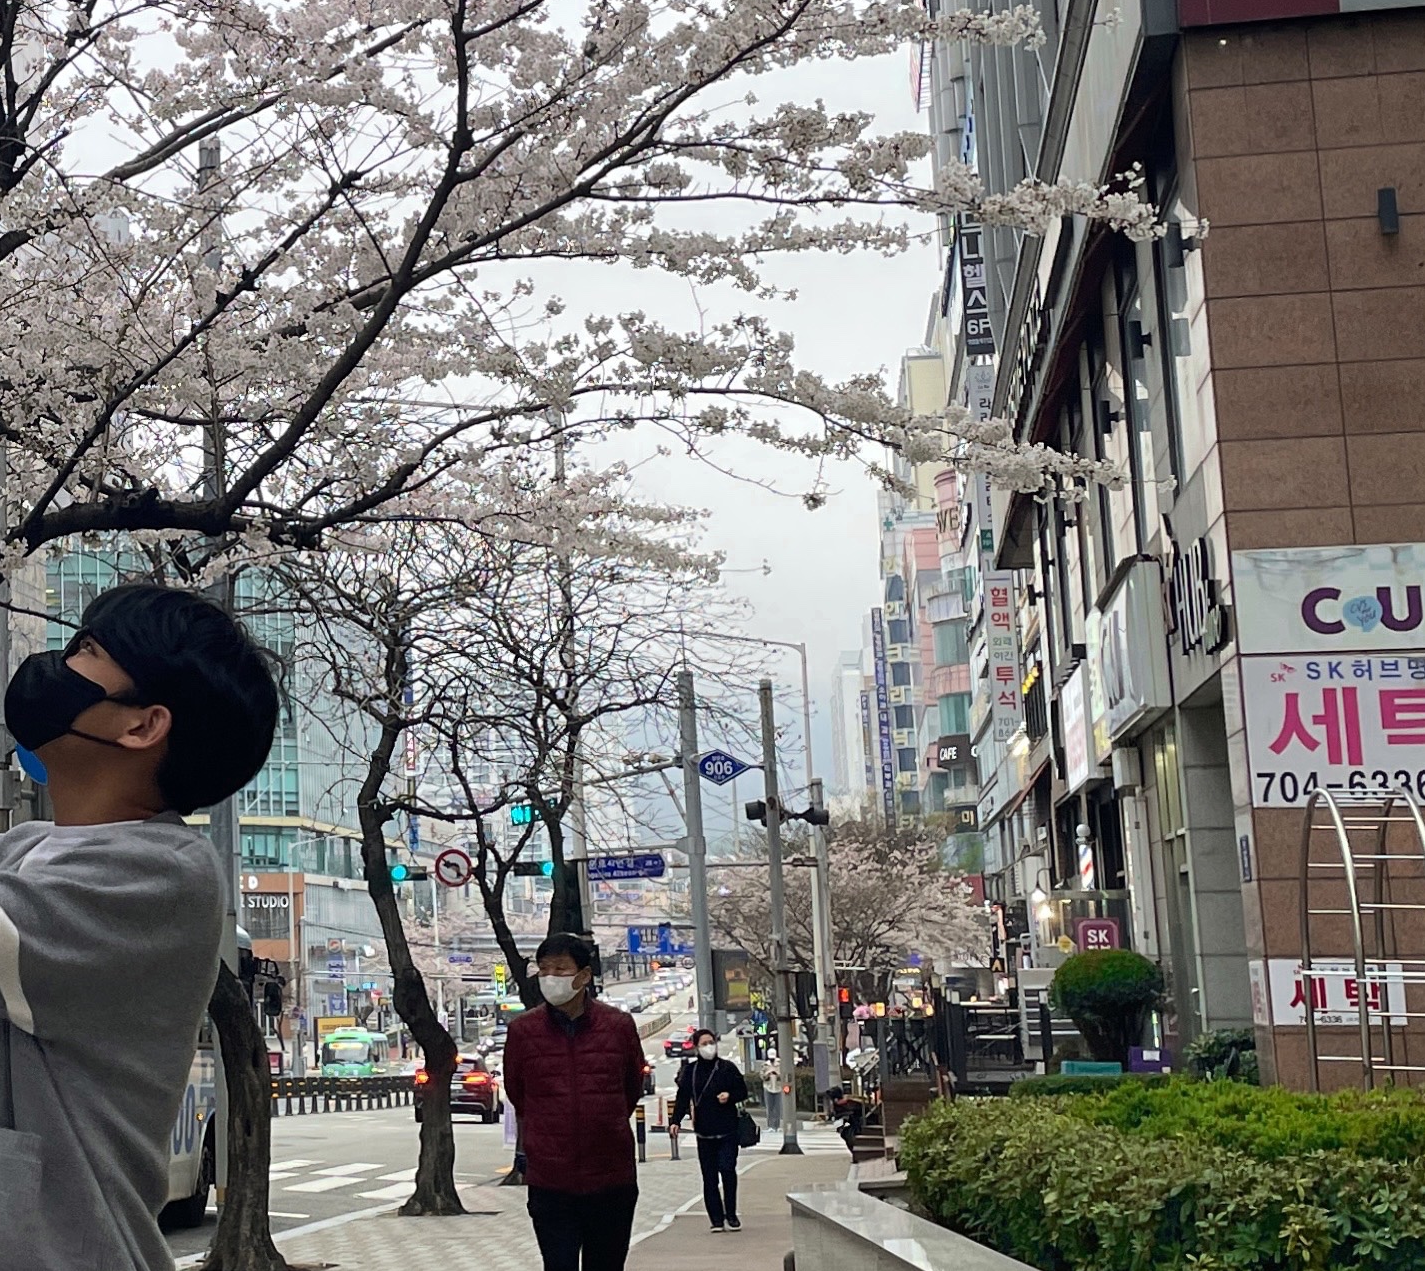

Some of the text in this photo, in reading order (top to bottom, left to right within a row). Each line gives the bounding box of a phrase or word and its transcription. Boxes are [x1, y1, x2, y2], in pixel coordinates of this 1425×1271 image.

[990, 587, 1010, 631] 혈액
[996, 666, 1017, 710] 투석
[940, 746, 957, 761] CAFE
[705, 760, 733, 775] 906
[248, 895, 289, 908] STUDIO
[1087, 929, 1110, 943] SK
